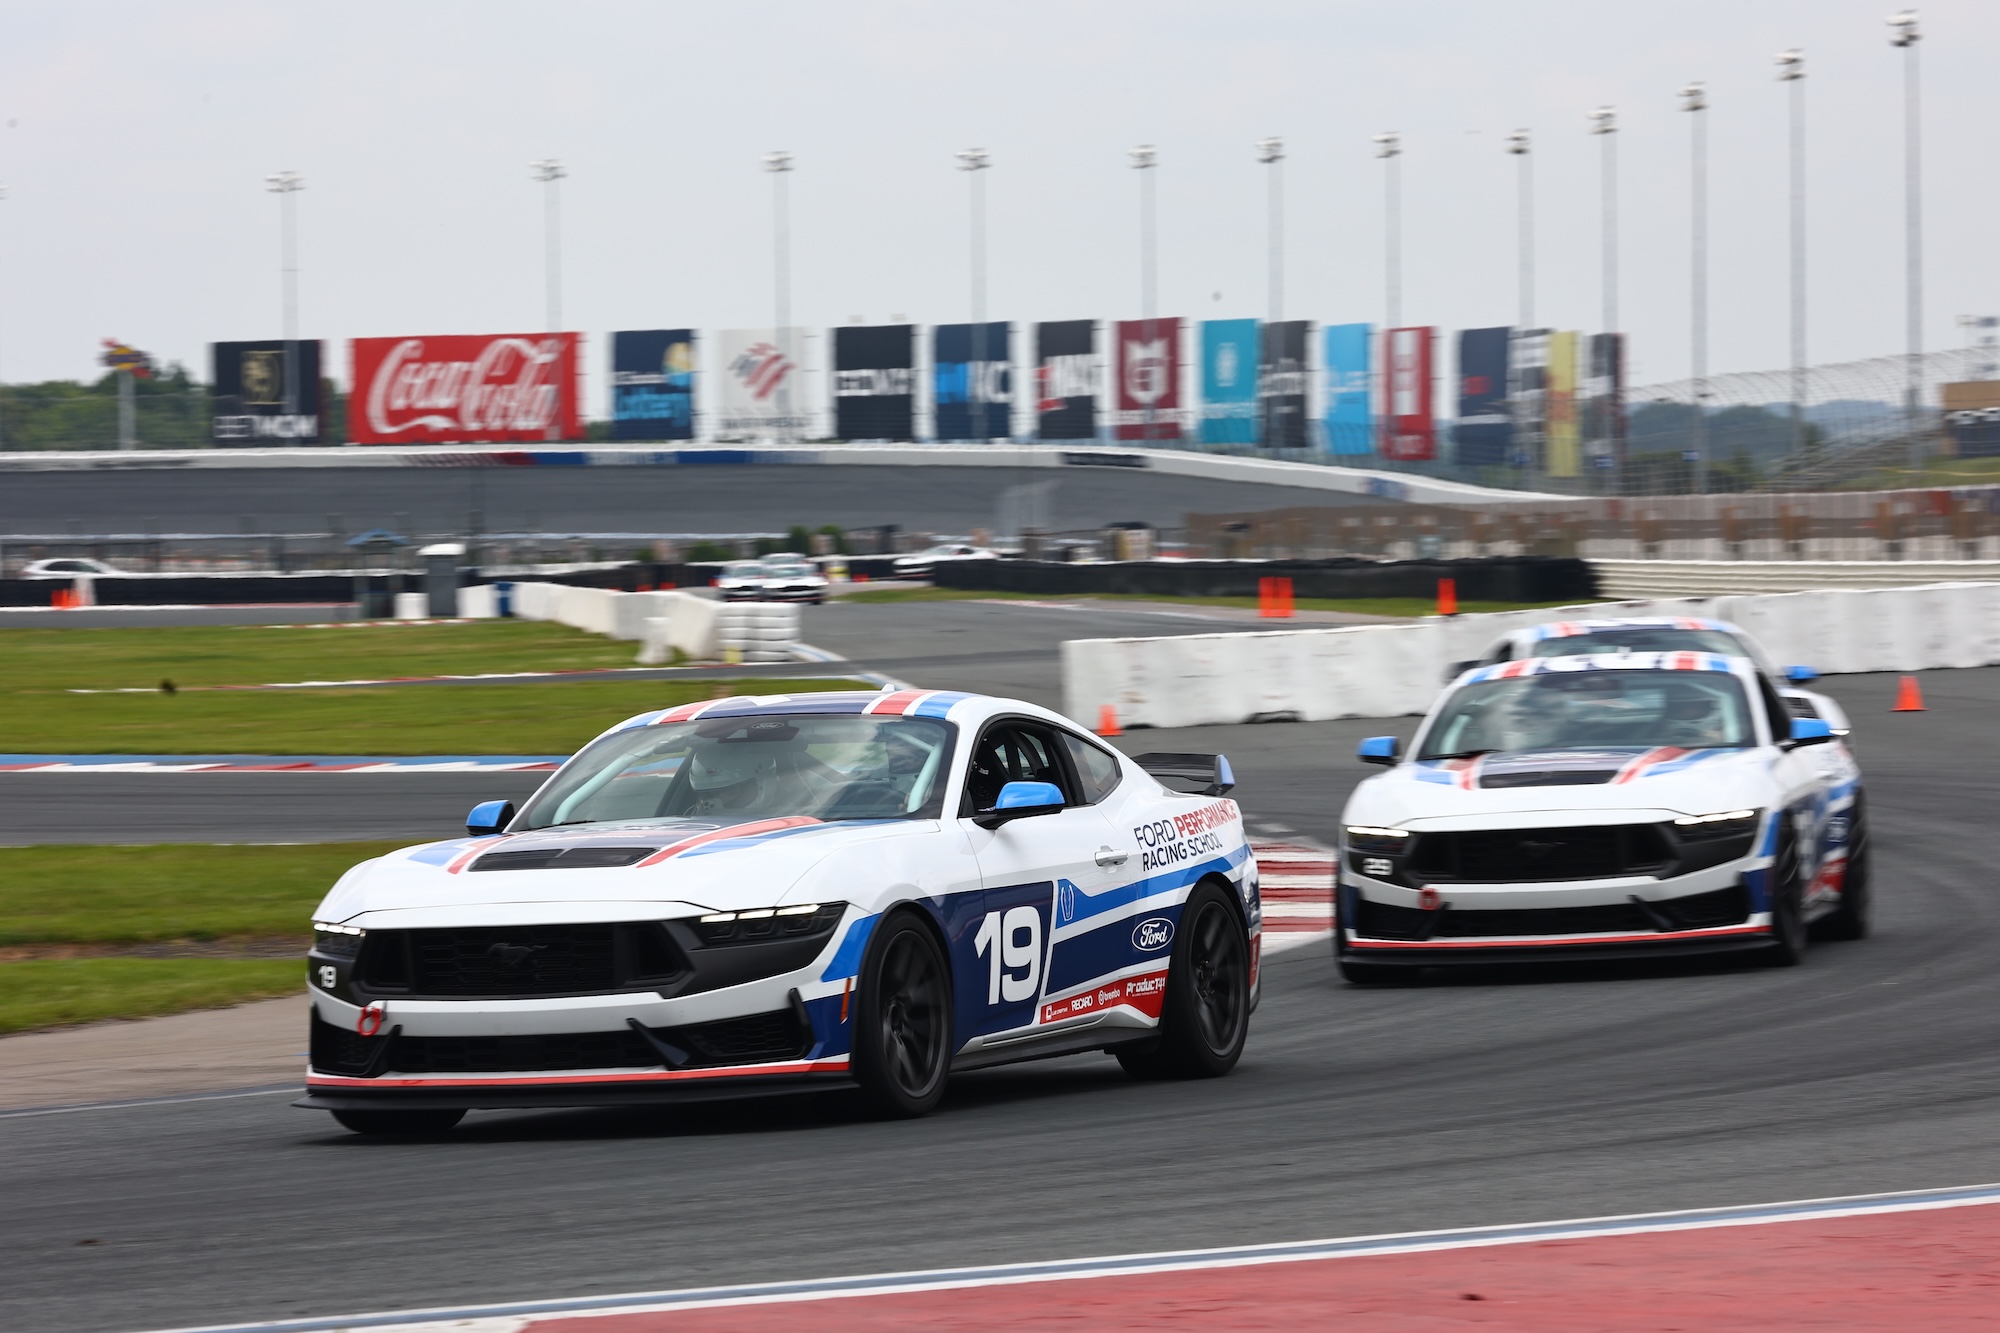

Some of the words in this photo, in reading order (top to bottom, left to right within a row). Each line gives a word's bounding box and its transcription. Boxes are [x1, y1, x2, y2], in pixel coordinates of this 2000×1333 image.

[1134, 820, 1176, 850] FORD
[1173, 799, 1237, 838] PERFORMANCE
[1142, 842, 1188, 872] RACING
[1187, 832, 1223, 857] SCHOOL
[1139, 922, 1169, 948] Ford
[974, 906, 1042, 1006] 19
[317, 964, 337, 988] 19
[1071, 995, 1094, 1012] RECARO
[1104, 988, 1121, 1002] brembo
